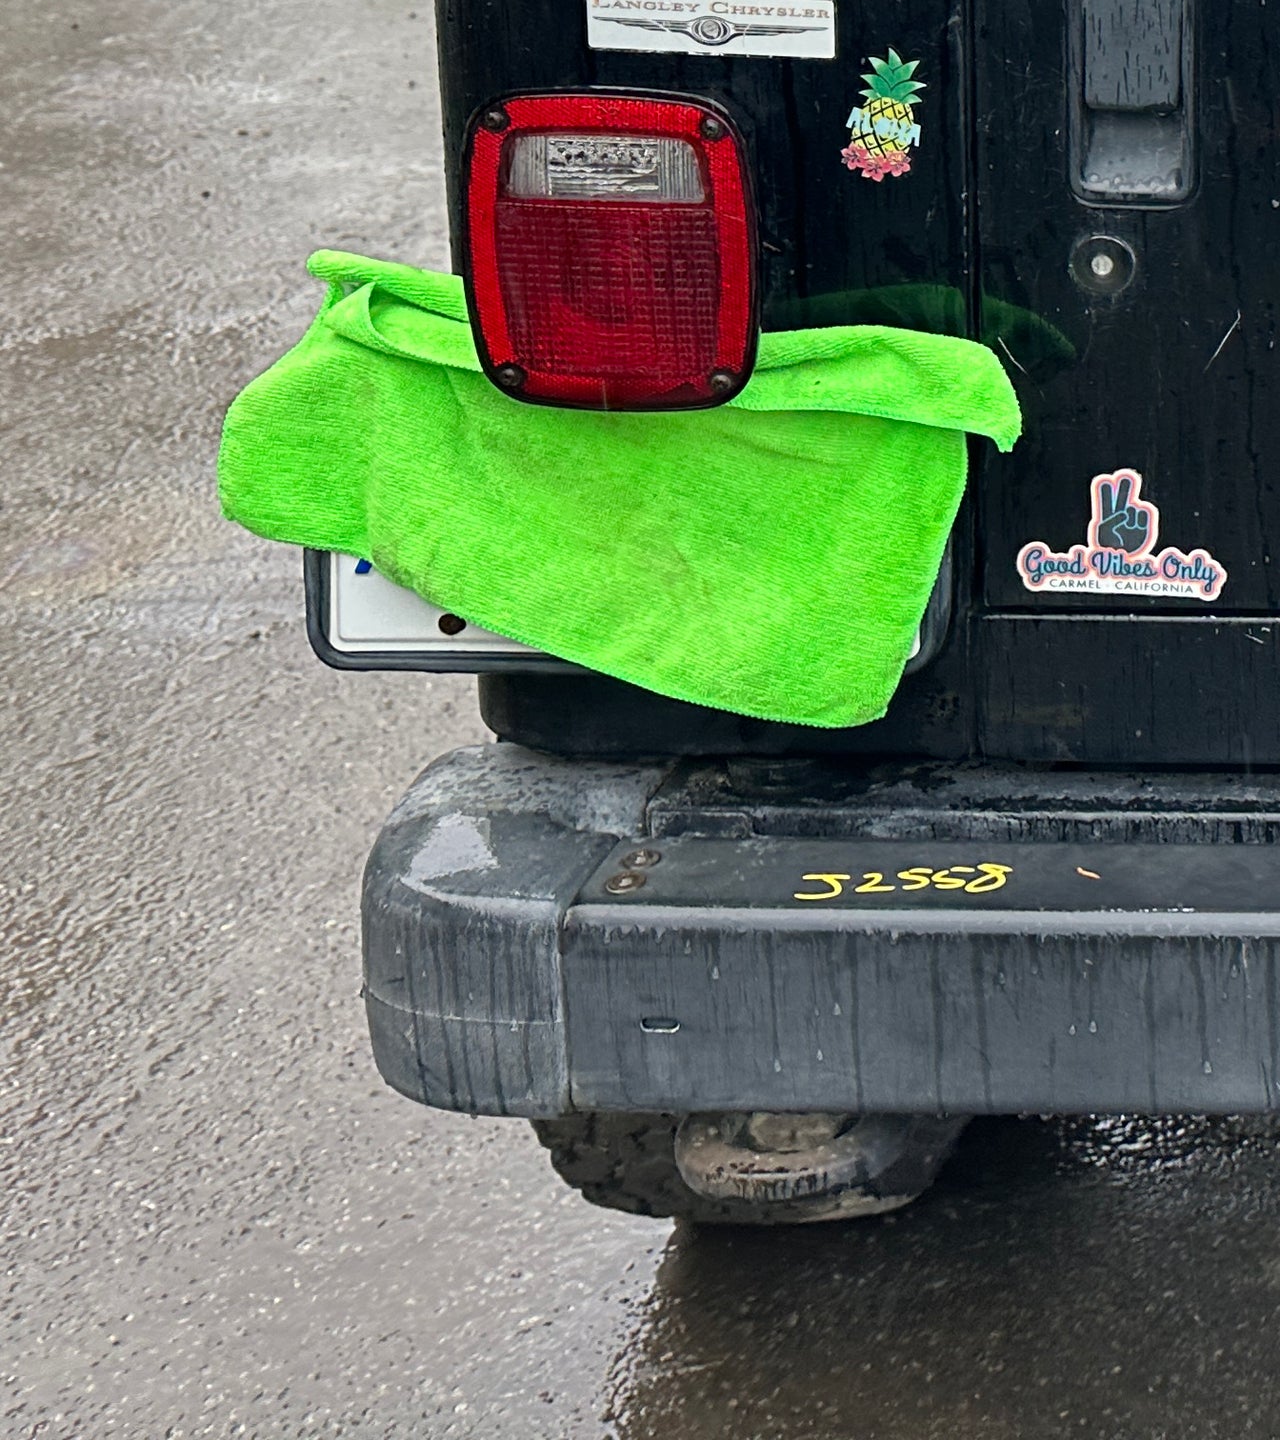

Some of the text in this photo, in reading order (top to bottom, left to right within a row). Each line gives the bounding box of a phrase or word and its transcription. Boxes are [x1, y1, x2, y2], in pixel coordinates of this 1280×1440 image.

[709, 1, 831, 19] CHRYSLER
[1025, 549, 1218, 593] Good Vibes Only
[1049, 578, 1194, 594] CARMEL CALIFORNIA
[794, 863, 1013, 901] J2558
